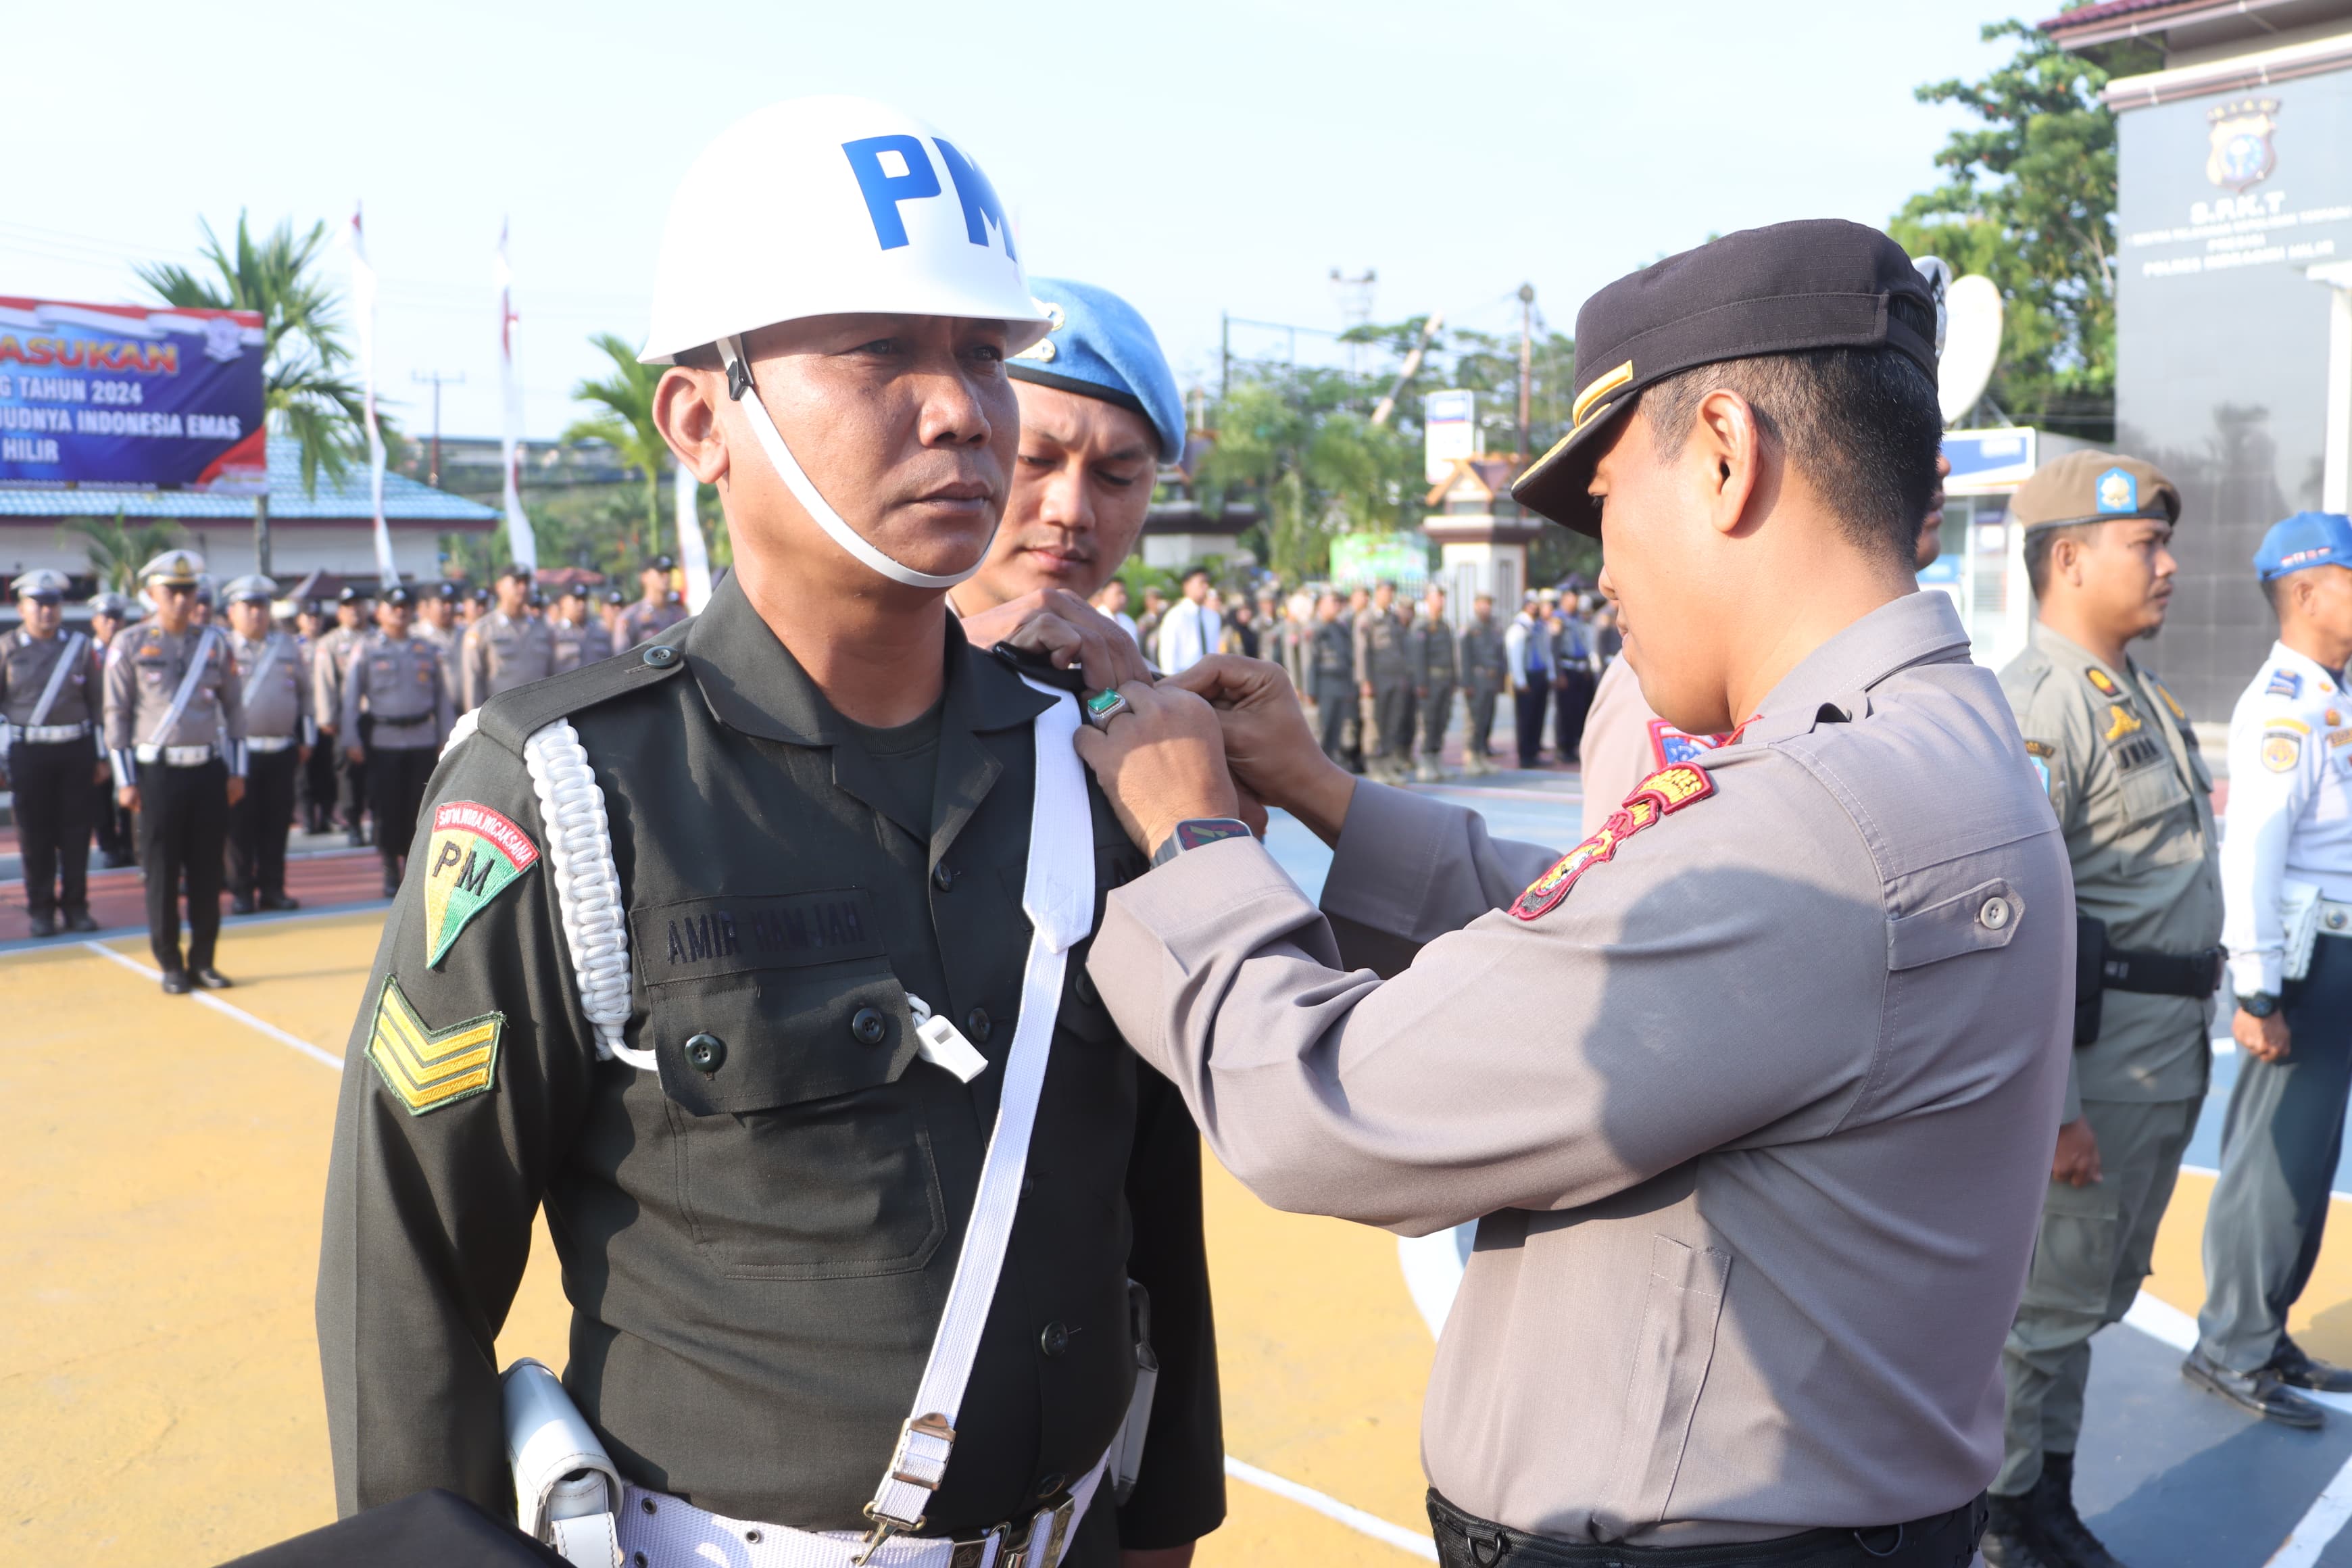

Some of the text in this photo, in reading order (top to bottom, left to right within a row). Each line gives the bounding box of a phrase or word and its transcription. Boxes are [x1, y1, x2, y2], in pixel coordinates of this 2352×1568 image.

[841, 134, 1018, 264] PM
[19, 376, 86, 402] TAHUN
[91, 380, 143, 405] 2024
[0, 407, 241, 440] UDNYA INDONESIA EMAS
[3, 438, 59, 463] HILIR
[432, 840, 495, 897] PM
[667, 910, 741, 965] AMIR
